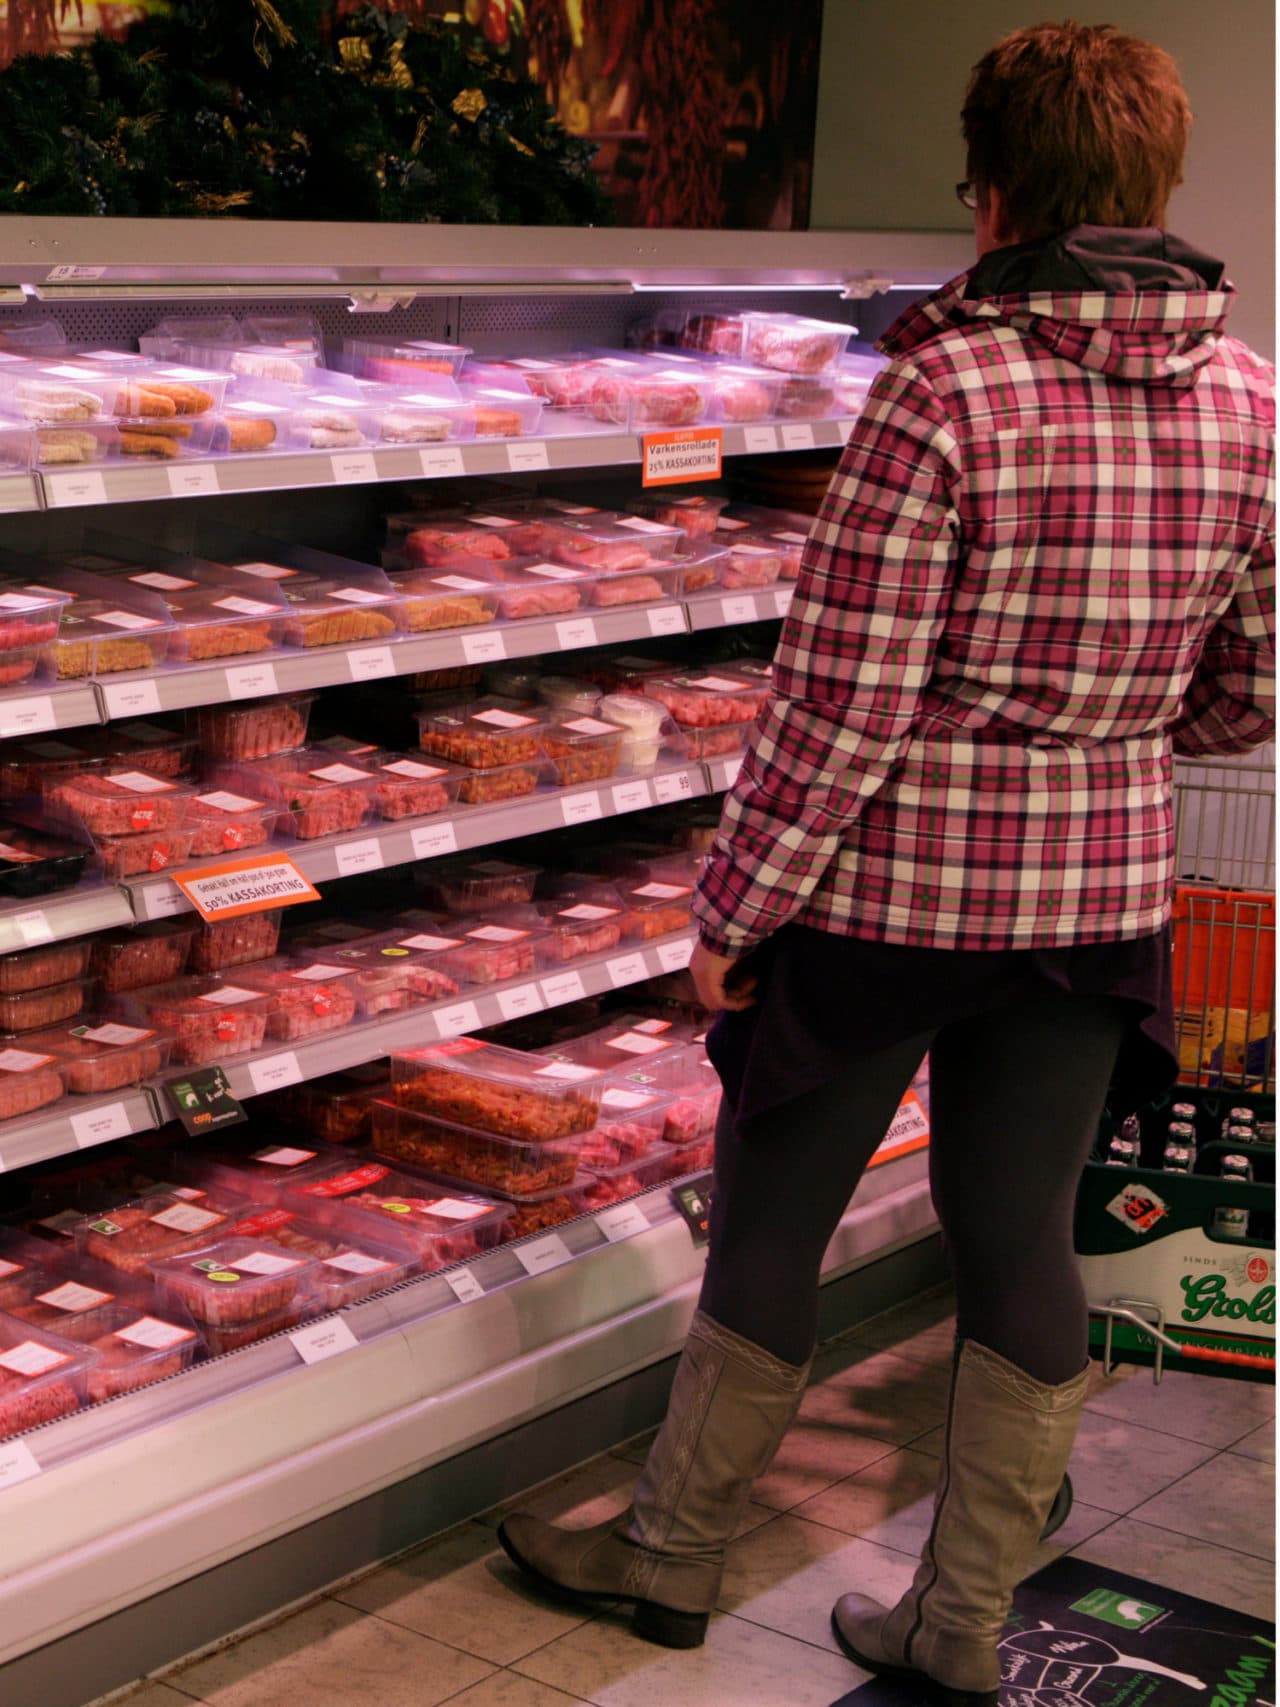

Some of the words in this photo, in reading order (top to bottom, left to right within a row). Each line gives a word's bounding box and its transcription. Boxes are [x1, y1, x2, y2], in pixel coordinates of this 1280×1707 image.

[649, 440, 717, 455] Varkensrollade
[649, 459, 664, 473] 25%
[665, 454, 716, 470] KASSAKORTING
[204, 896, 229, 911] 50%
[228, 879, 304, 903] KASSAKORTING
